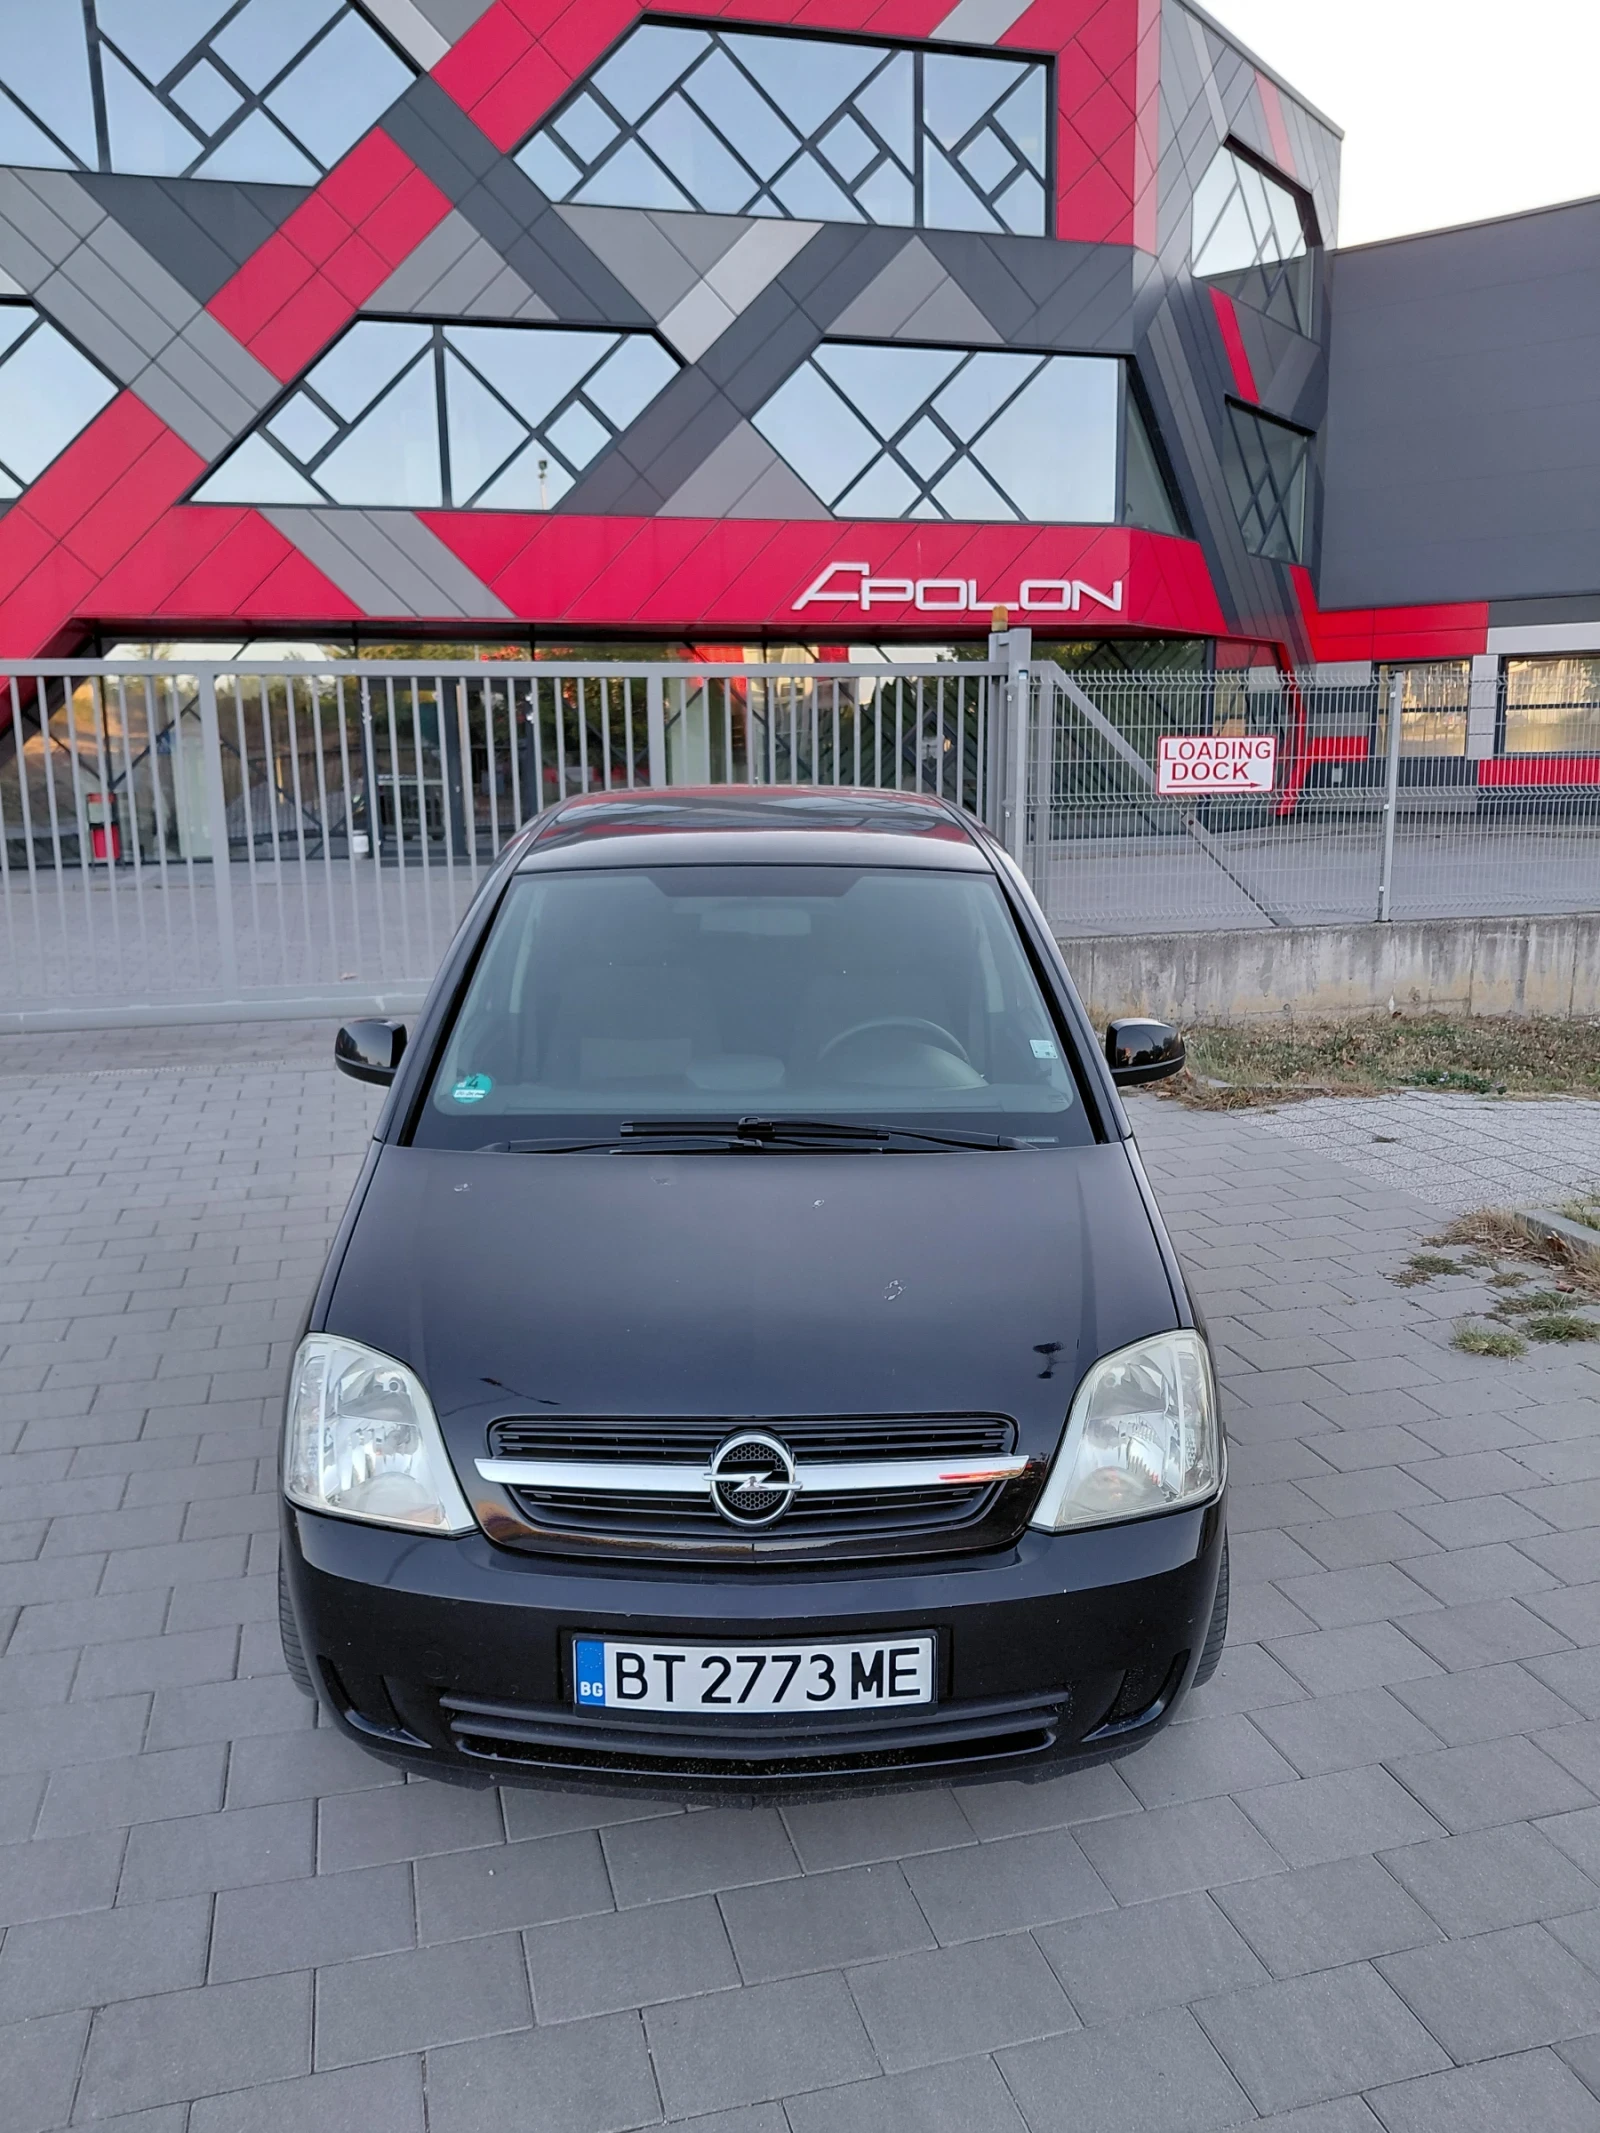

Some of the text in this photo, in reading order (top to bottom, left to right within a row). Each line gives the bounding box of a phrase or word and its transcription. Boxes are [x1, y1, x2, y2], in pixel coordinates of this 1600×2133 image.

[791, 561, 1123, 611] APOLON
[1164, 741, 1271, 760] LOADING
[1171, 761, 1249, 780] DOCK
[615, 1646, 921, 1704] BT 2773 ME
[580, 1681, 603, 1697] BG
